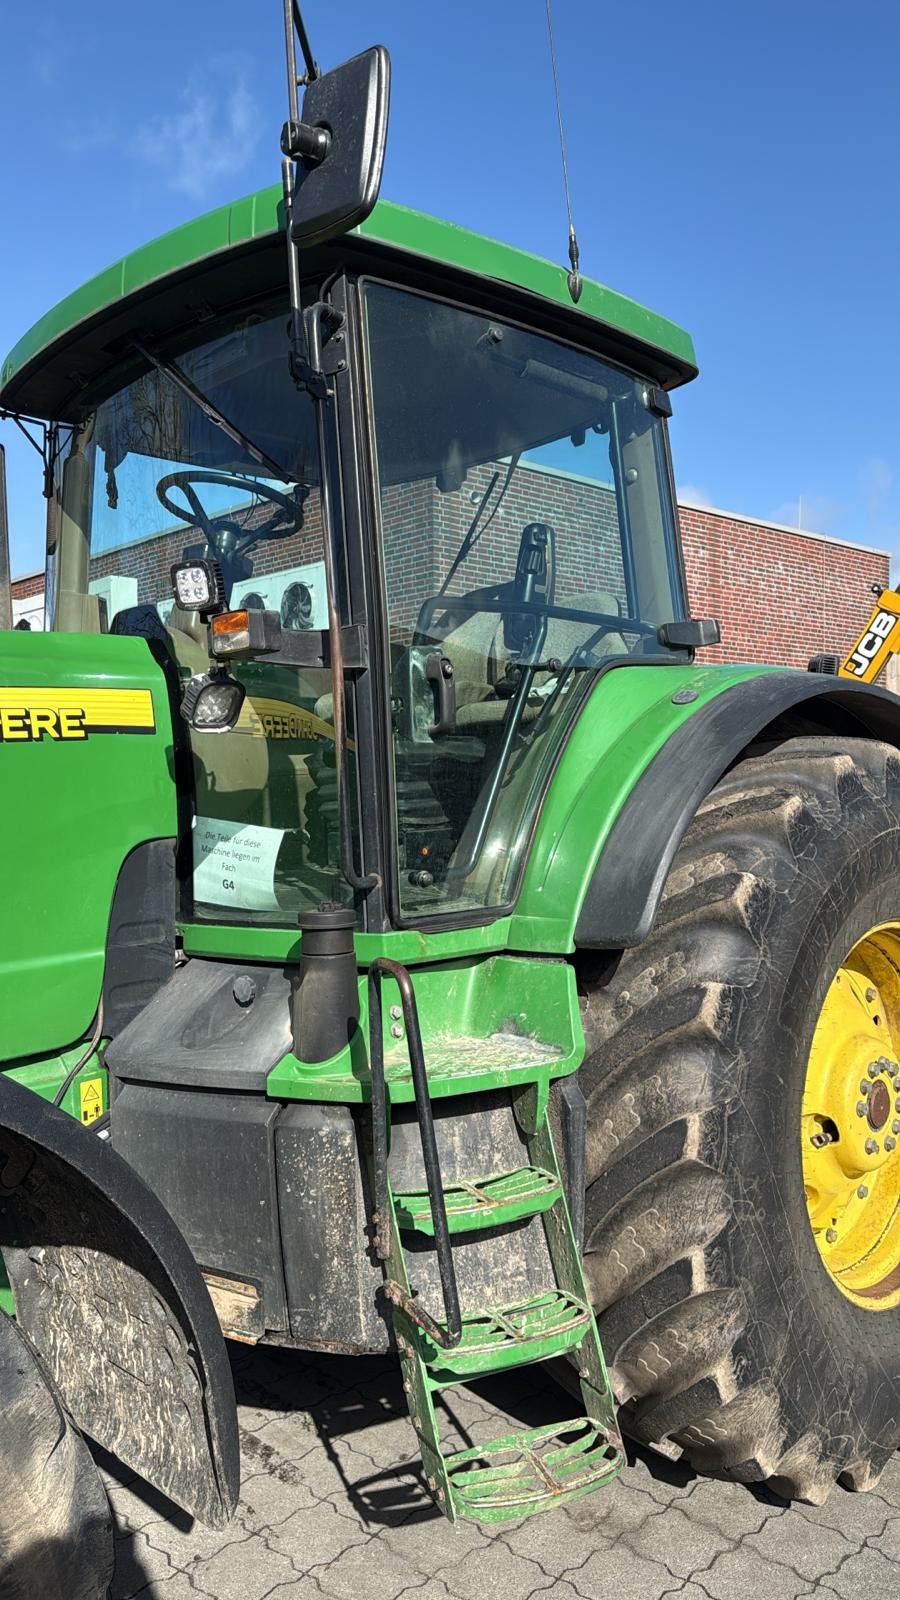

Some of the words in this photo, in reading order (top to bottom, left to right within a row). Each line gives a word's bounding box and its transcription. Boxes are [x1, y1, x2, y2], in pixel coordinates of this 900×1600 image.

[851, 612, 896, 675] JCB
[205, 831, 216, 840] Die
[218, 833, 232, 842] Teile
[233, 836, 243, 845] für
[244, 839, 261, 848] diese
[201, 845, 231, 857] Maschine
[232, 849, 251, 861] liegen
[252, 855, 261, 863] im
[222, 862, 236, 872] Fach
[222, 879, 235, 890] G4
